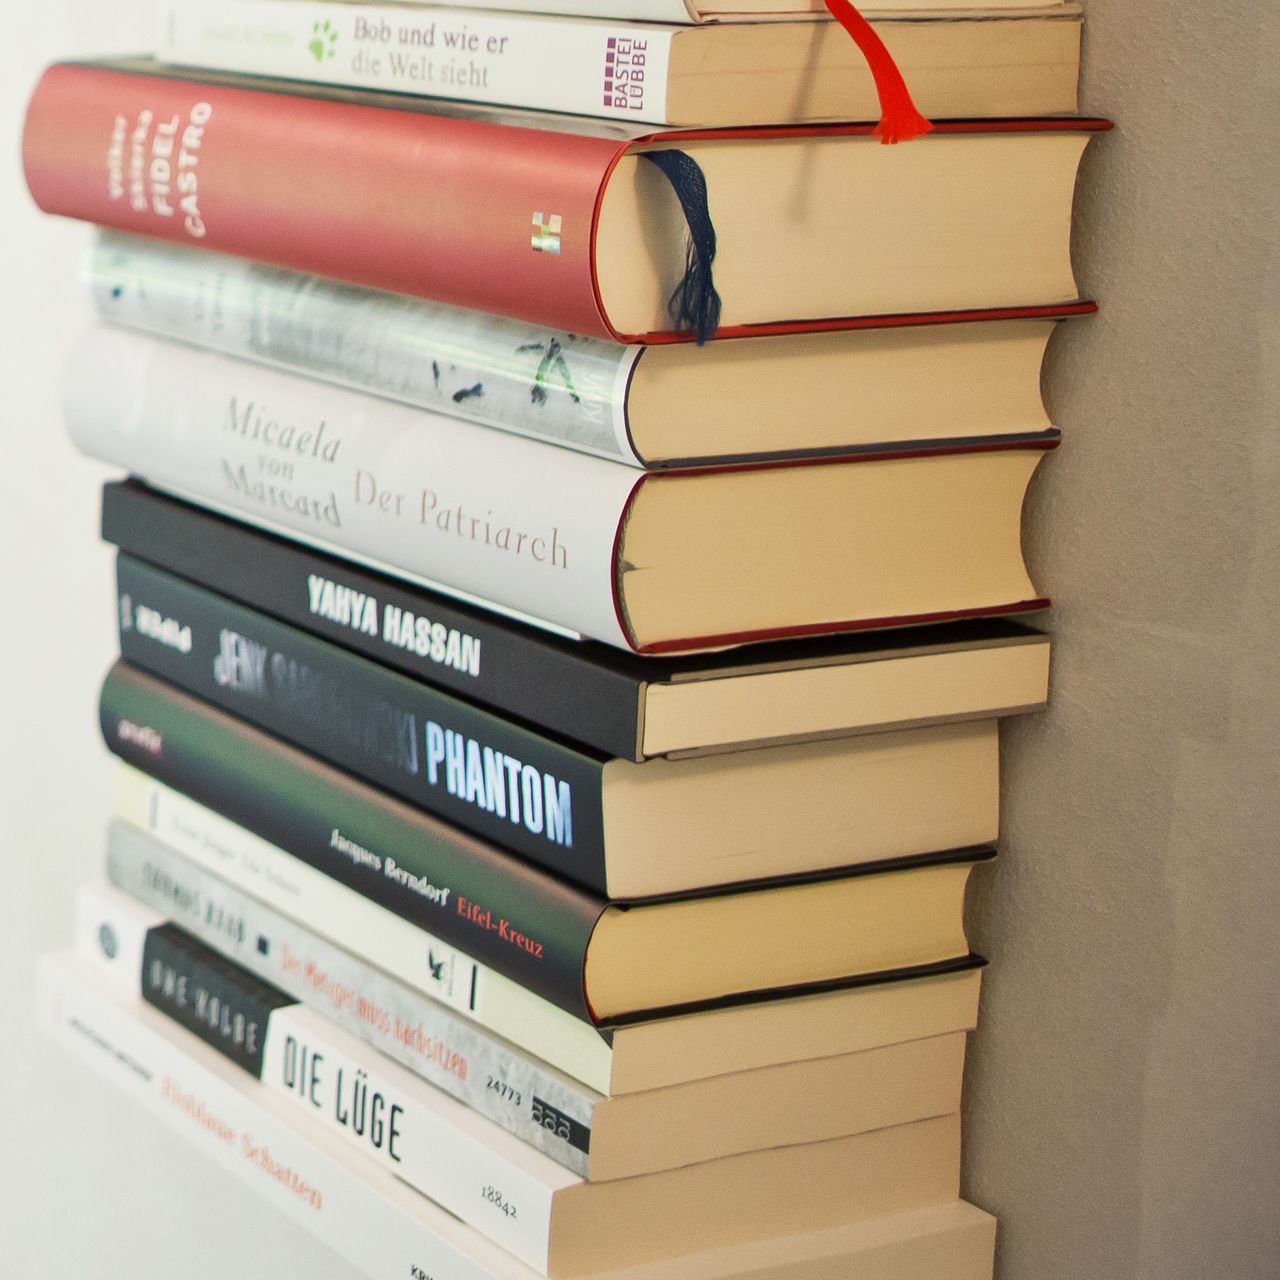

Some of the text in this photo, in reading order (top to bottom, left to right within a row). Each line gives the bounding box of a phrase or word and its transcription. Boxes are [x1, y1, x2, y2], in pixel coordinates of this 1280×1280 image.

[351, 47, 490, 89] die Welt sieht
[354, 16, 509, 56] Bob und wie er
[614, 36, 632, 109] BASTEI
[629, 38, 648, 111] LÜBBE
[150, 114, 180, 217] FIDEL
[177, 102, 213, 238] CASTRO
[225, 396, 341, 464] Micaela
[221, 458, 342, 527] Marcard
[256, 453, 294, 481] von
[353, 467, 570, 570] Der Patriarch
[307, 573, 481, 678] YAHYA HASSAN
[425, 719, 574, 849] PHANTOM
[330, 828, 382, 871] Jacques
[384, 857, 450, 906] Berndorf
[456, 896, 544, 959] Eifel-Kreuz
[356, 996, 390, 1034] muss
[394, 1015, 469, 1081] nachsitzen
[284, 1034, 404, 1163] DIE LÜGE
[487, 1074, 522, 1107] 24773
[481, 1185, 519, 1220] 18842
